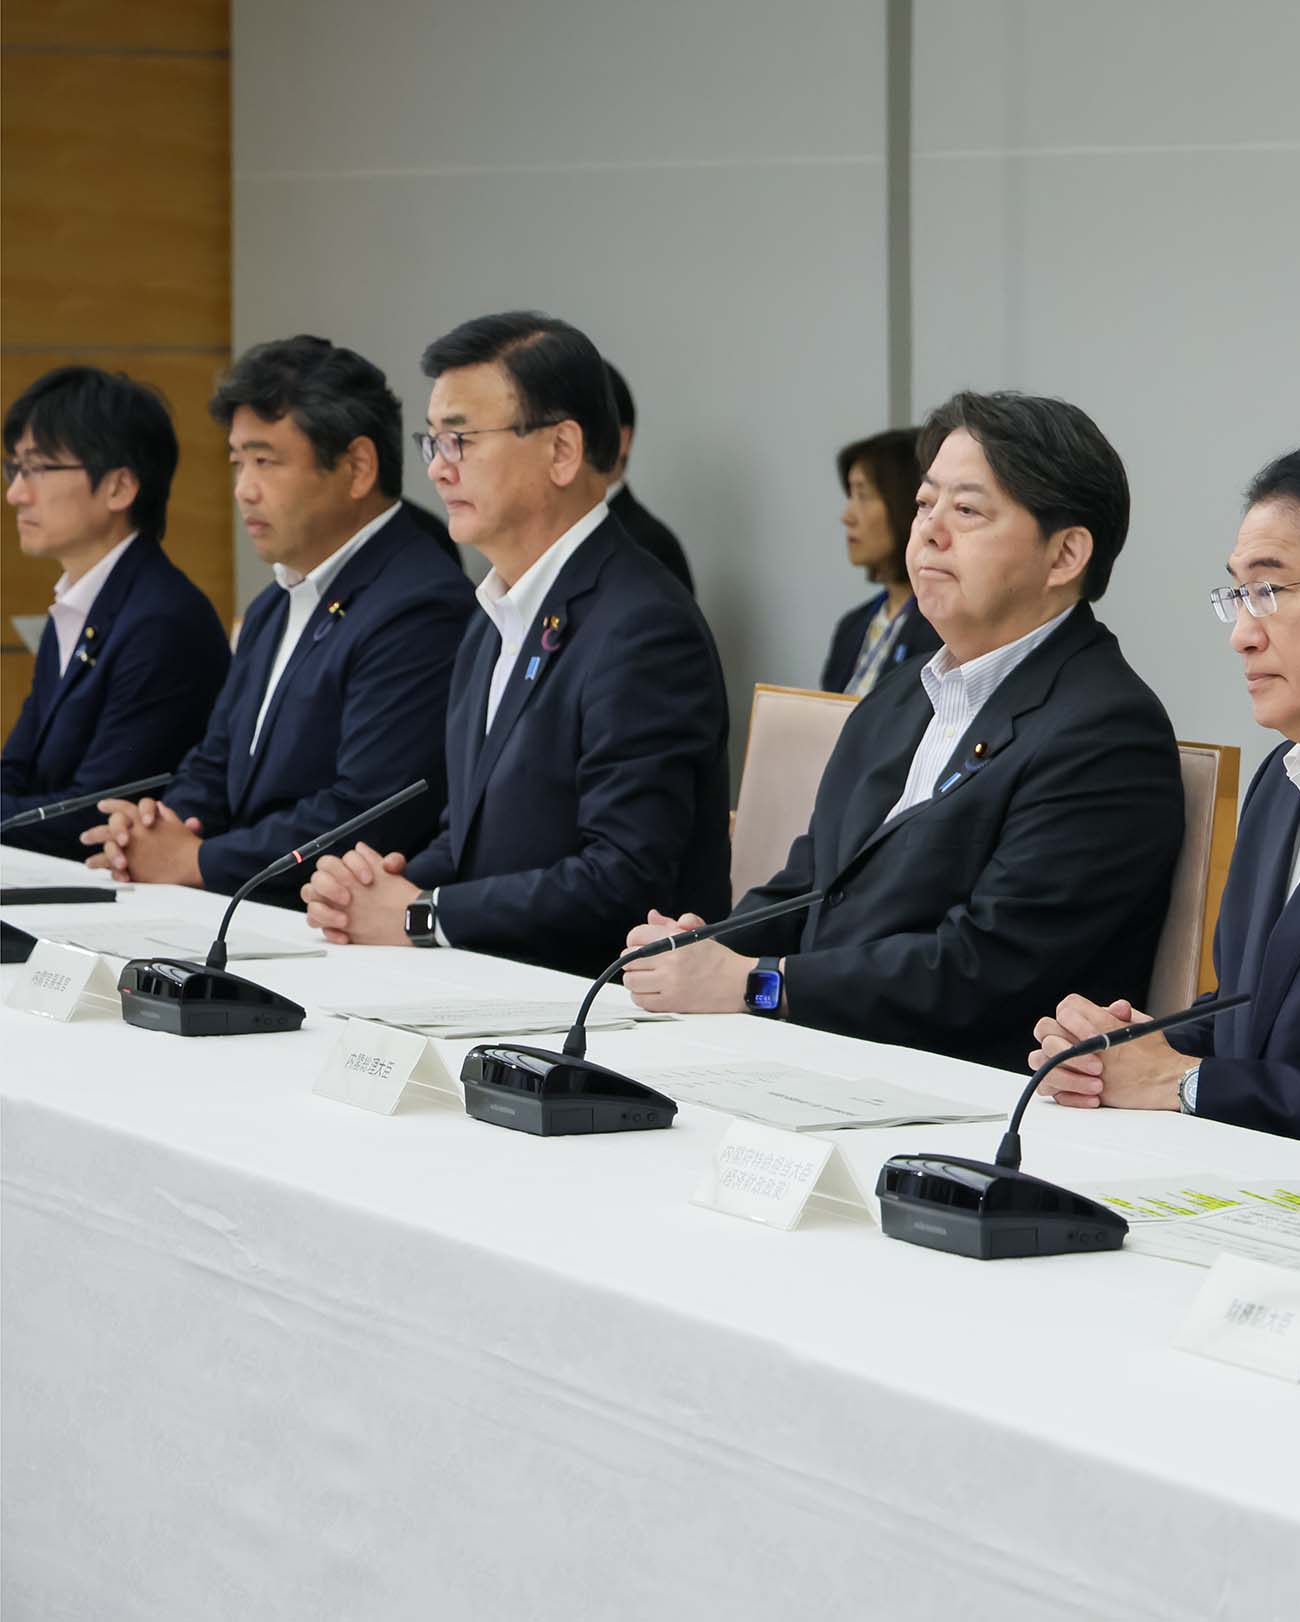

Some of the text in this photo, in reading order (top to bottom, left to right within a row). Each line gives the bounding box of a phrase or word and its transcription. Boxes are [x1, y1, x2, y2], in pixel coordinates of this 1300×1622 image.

[344, 1052, 396, 1079] 内閣総理大臣
